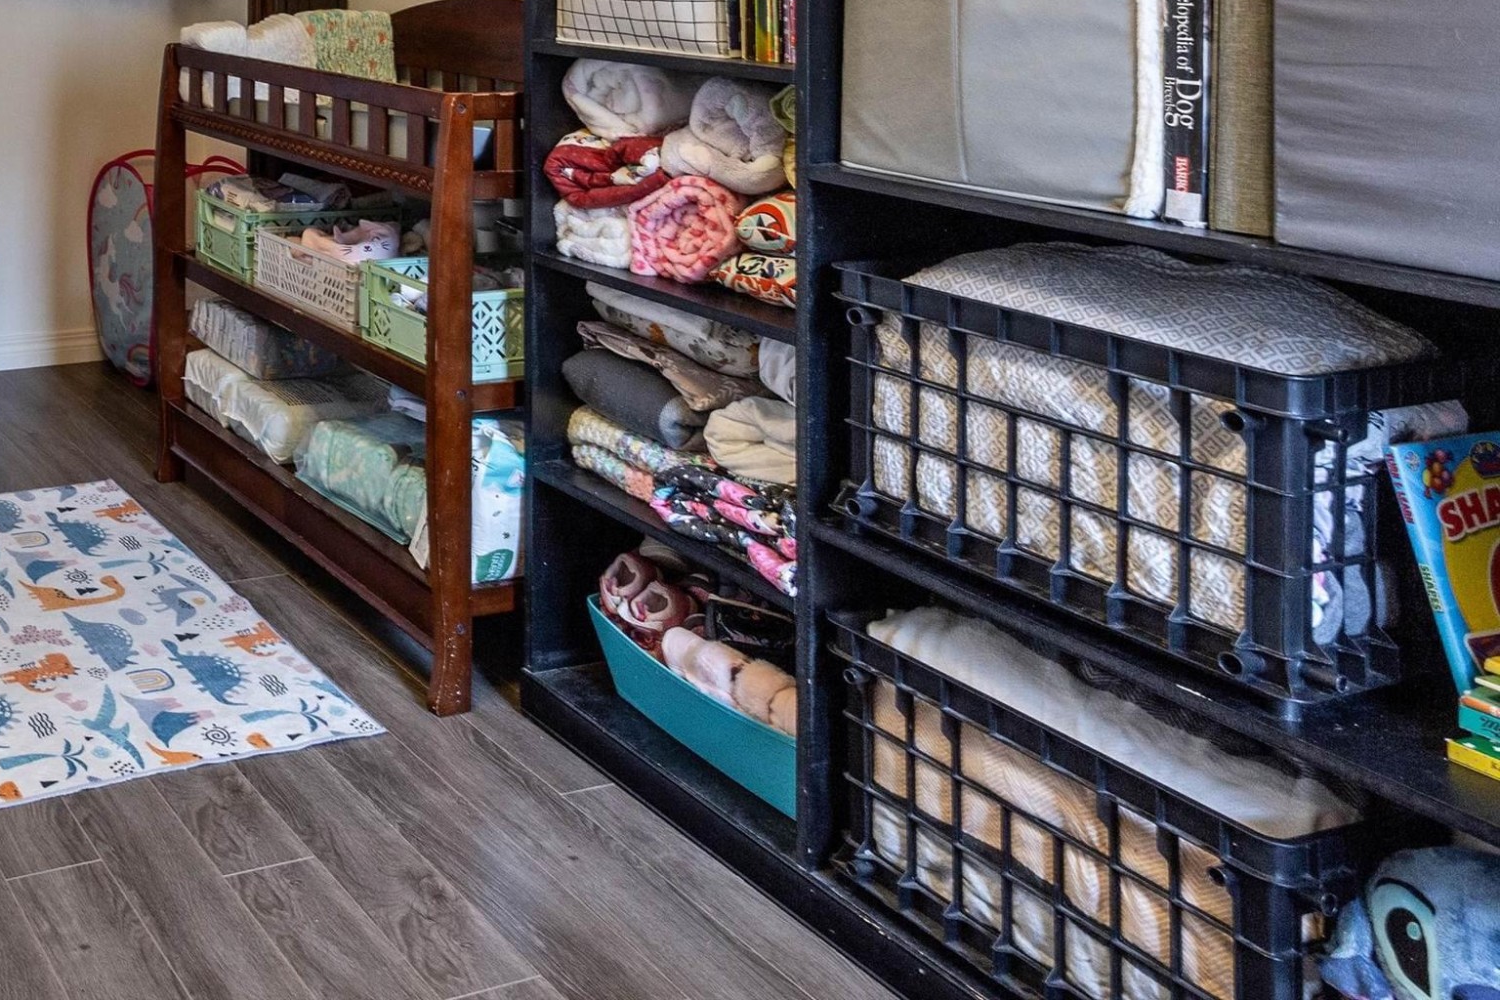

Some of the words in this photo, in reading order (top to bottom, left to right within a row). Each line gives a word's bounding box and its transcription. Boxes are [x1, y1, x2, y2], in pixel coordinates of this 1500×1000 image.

[1176, 56, 1194, 73] of
[1164, 76, 1176, 112] Breeds
[1164, 78, 1202, 130] Dog
[1420, 564, 1443, 611] SHAPES
